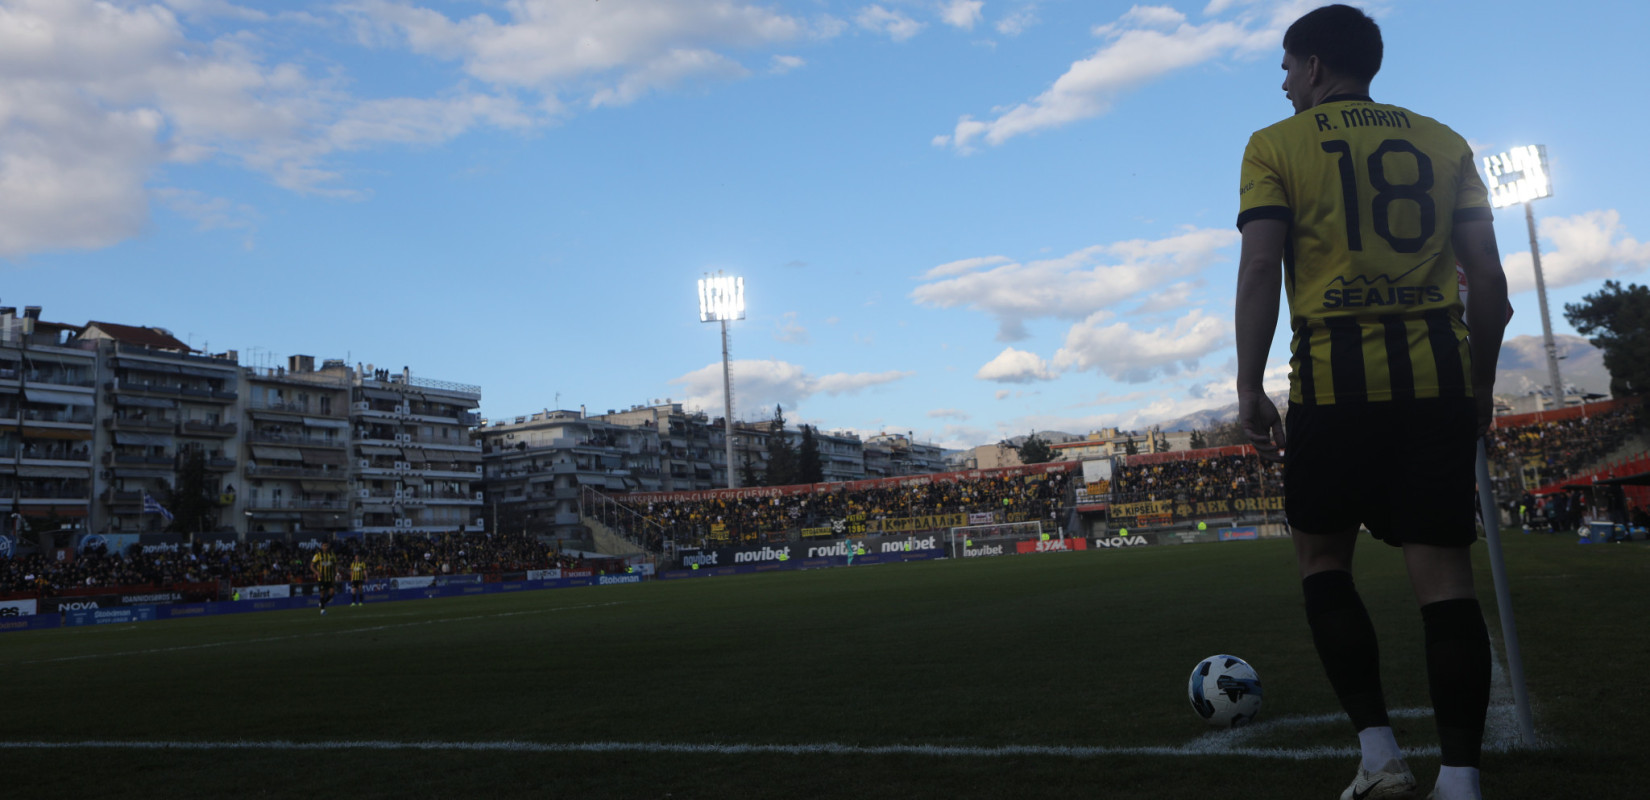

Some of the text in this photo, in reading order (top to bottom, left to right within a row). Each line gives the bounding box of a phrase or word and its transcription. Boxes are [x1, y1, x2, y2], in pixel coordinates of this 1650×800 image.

[1314, 107, 1411, 132] R. MARIN
[1320, 139, 1436, 254] 18
[1322, 284, 1445, 309] SEAJETS
[1125, 505, 1159, 515] KIPSELI
[1196, 500, 1229, 515] AEK
[881, 536, 936, 553] novibet
[963, 544, 1003, 557] novibet
[1095, 536, 1148, 549] NOVA
[683, 551, 718, 567] novibet
[734, 546, 790, 563] novibet
[58, 601, 99, 612] NOVA
